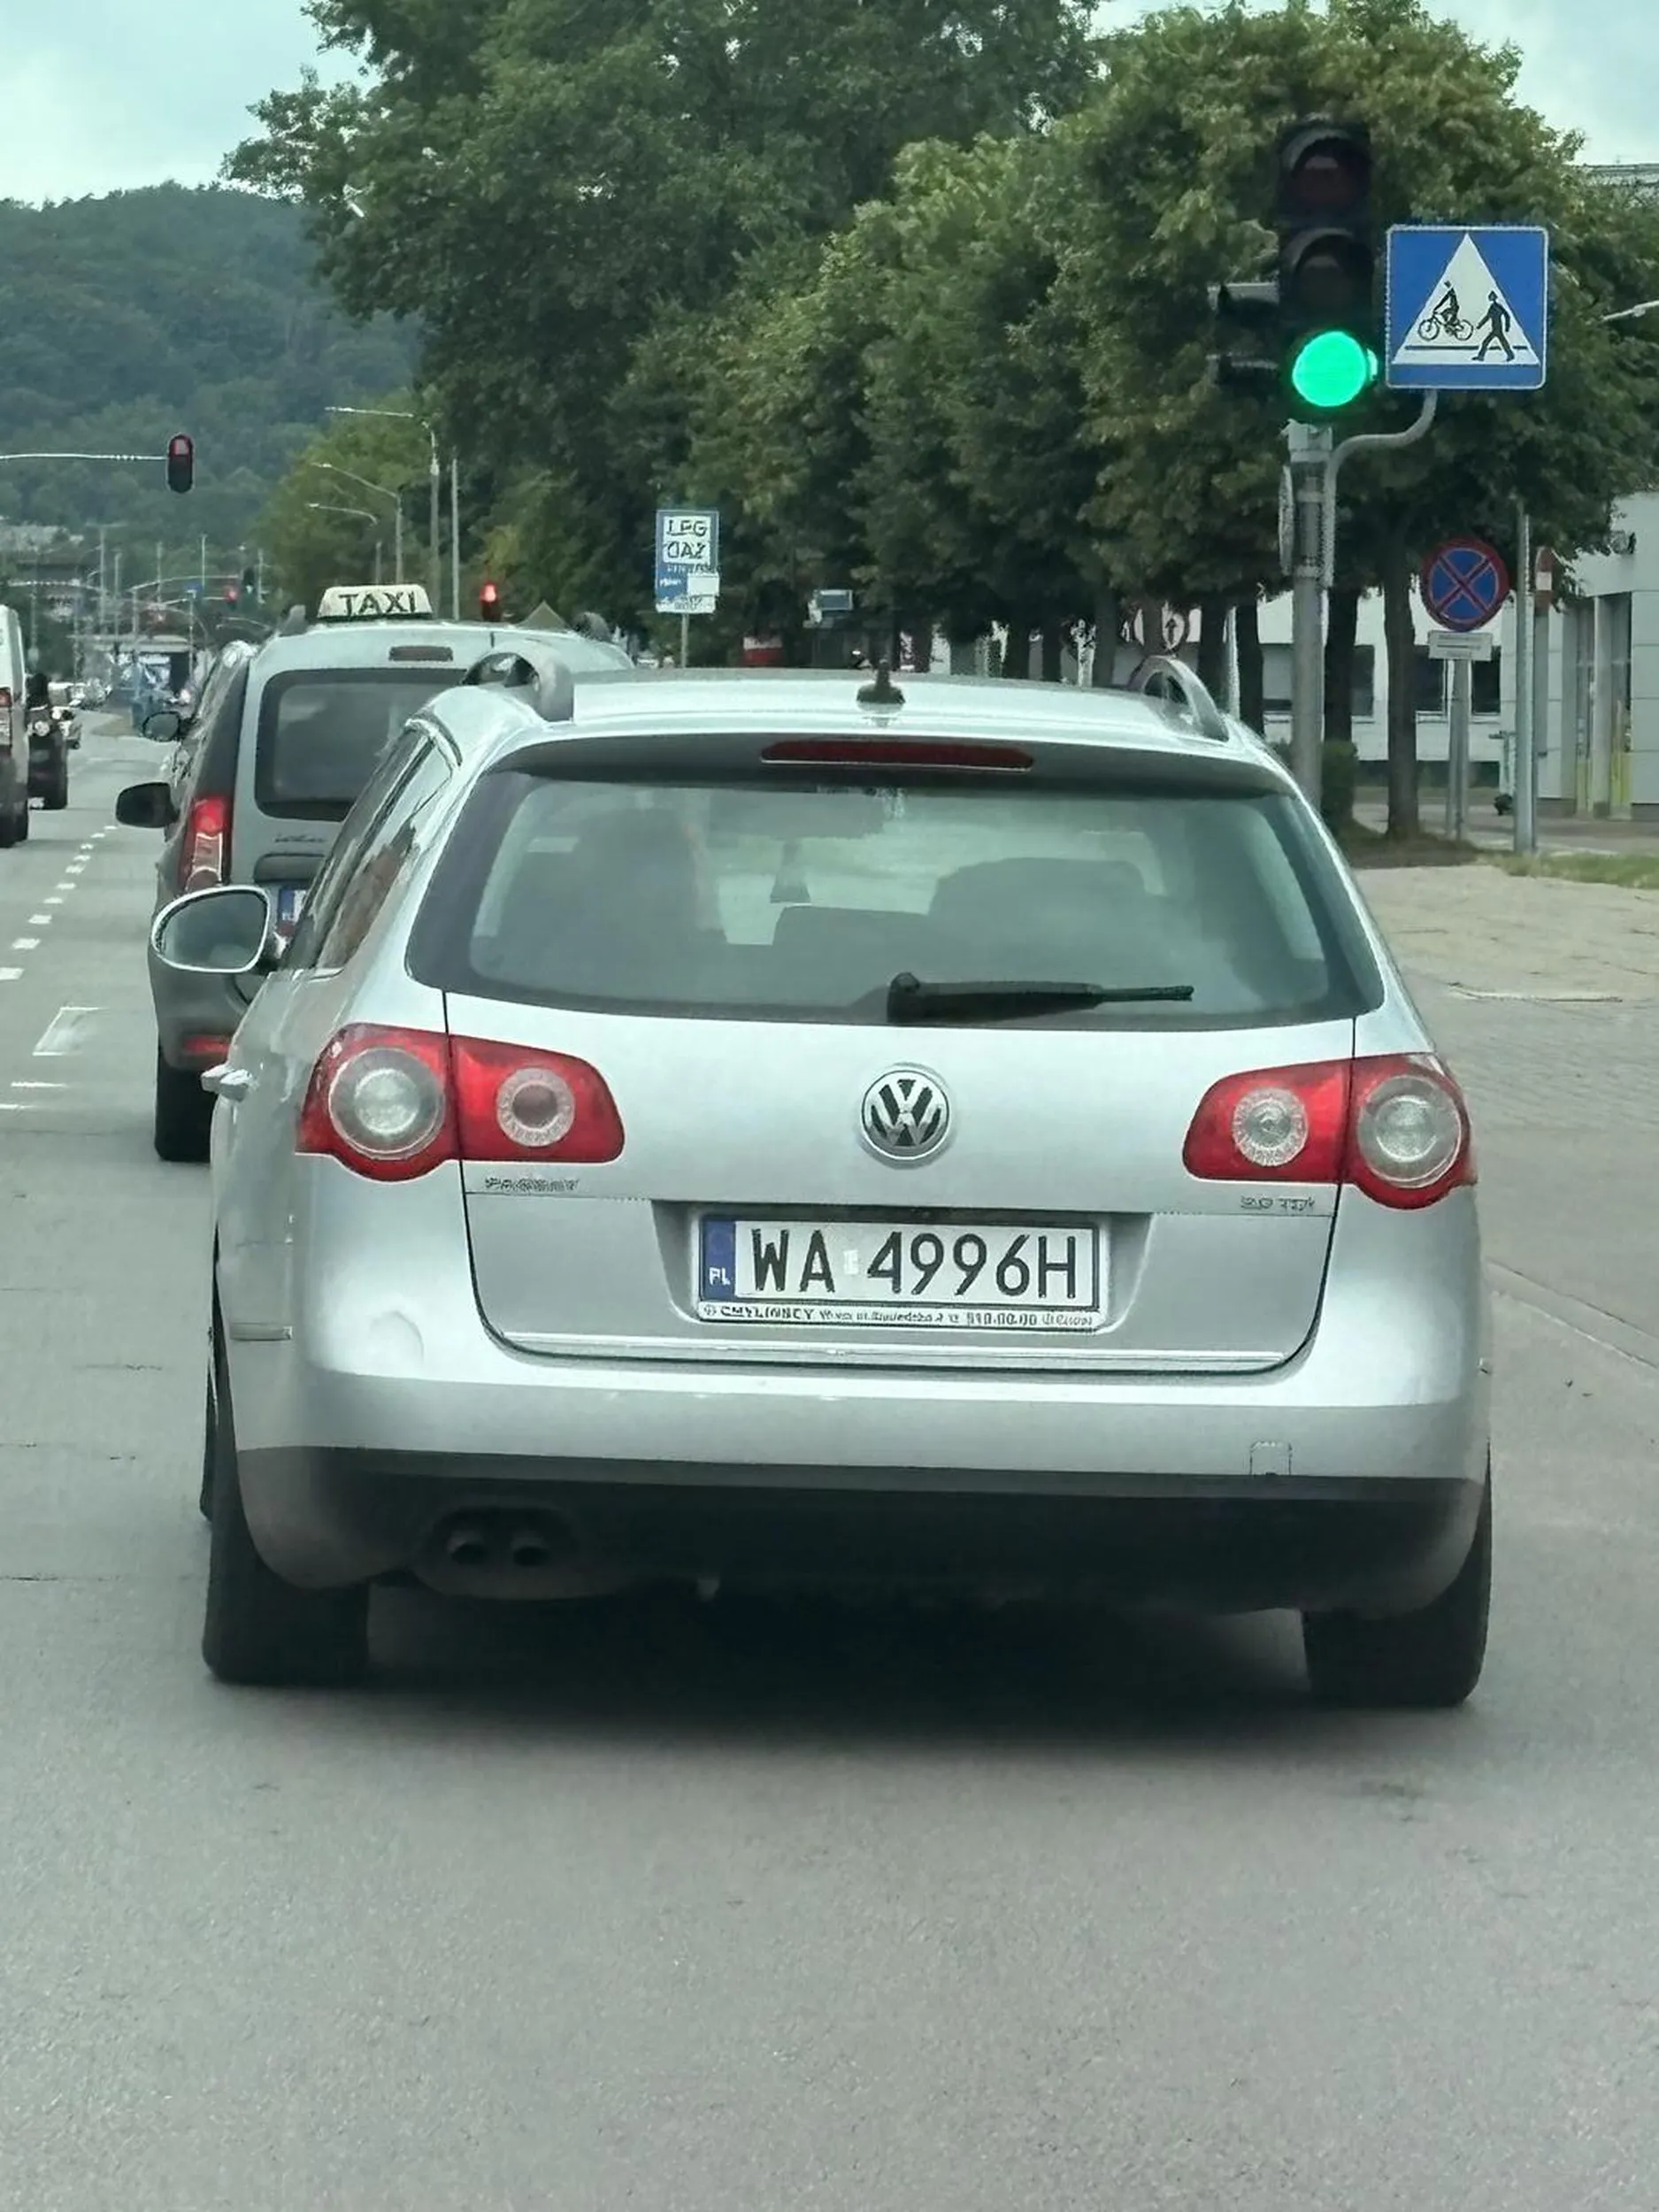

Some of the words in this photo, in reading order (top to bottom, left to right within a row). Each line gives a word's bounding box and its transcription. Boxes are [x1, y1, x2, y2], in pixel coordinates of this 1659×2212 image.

[338, 590, 418, 618] TAXI
[709, 1267, 731, 1286] PL
[750, 1227, 836, 1293] WA
[866, 1230, 1077, 1299] 4996H
